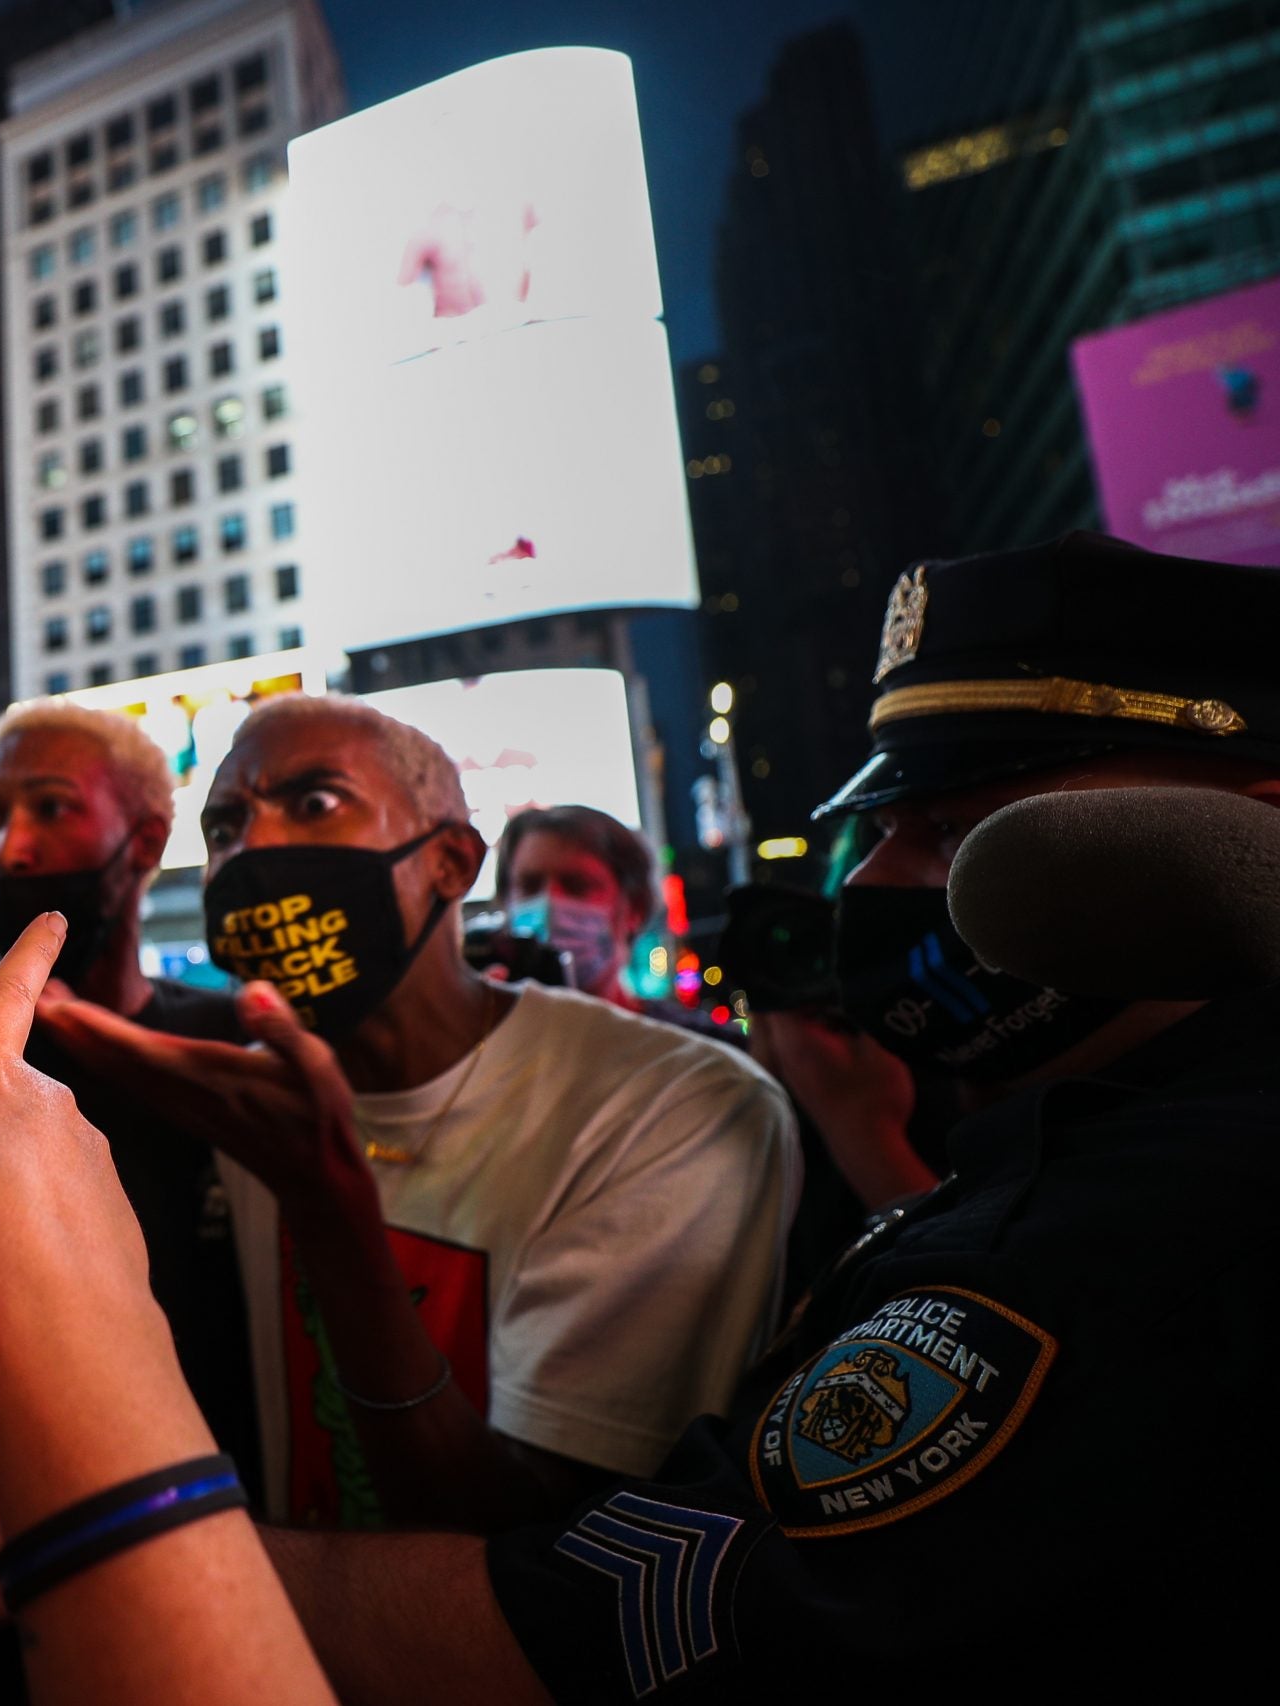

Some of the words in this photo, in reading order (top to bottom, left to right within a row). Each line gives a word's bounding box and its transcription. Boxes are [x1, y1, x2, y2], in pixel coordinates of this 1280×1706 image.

[872, 1298, 967, 1334] POLICE
[763, 1429, 783, 1467] OF
[817, 1474, 895, 1515] NEW
[895, 1411, 989, 1486] YORK
